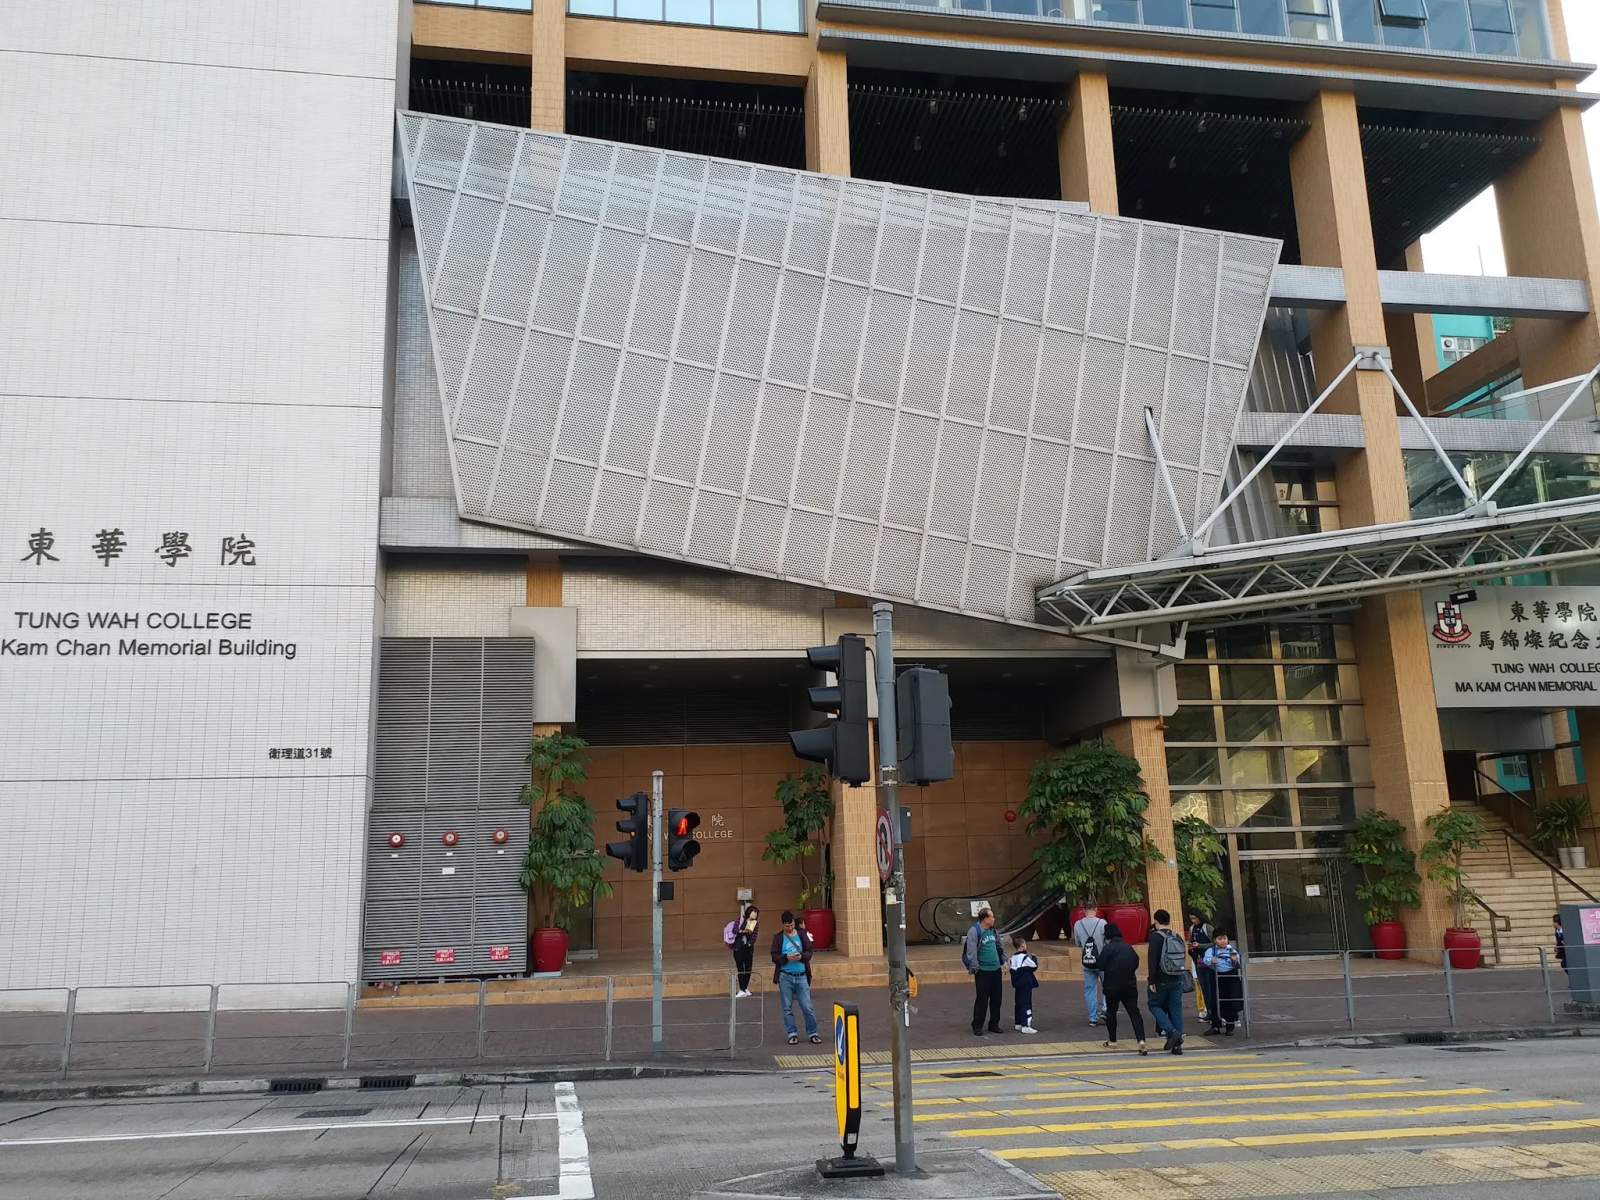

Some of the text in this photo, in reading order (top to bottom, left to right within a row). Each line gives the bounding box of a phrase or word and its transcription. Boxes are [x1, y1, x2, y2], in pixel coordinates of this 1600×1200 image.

[20, 527, 257, 567] 東華學院
[14, 612, 252, 629] TUNG WAH COLLEGE
[1510, 600, 1598, 623] 東華學院
[1, 638, 297, 661] Kam Chan Memorial Building
[1492, 663, 1525, 674] TUNG
[1528, 663, 1555, 674] WAH
[1455, 680, 1598, 693] MA KAM CHAN MEMORIAL
